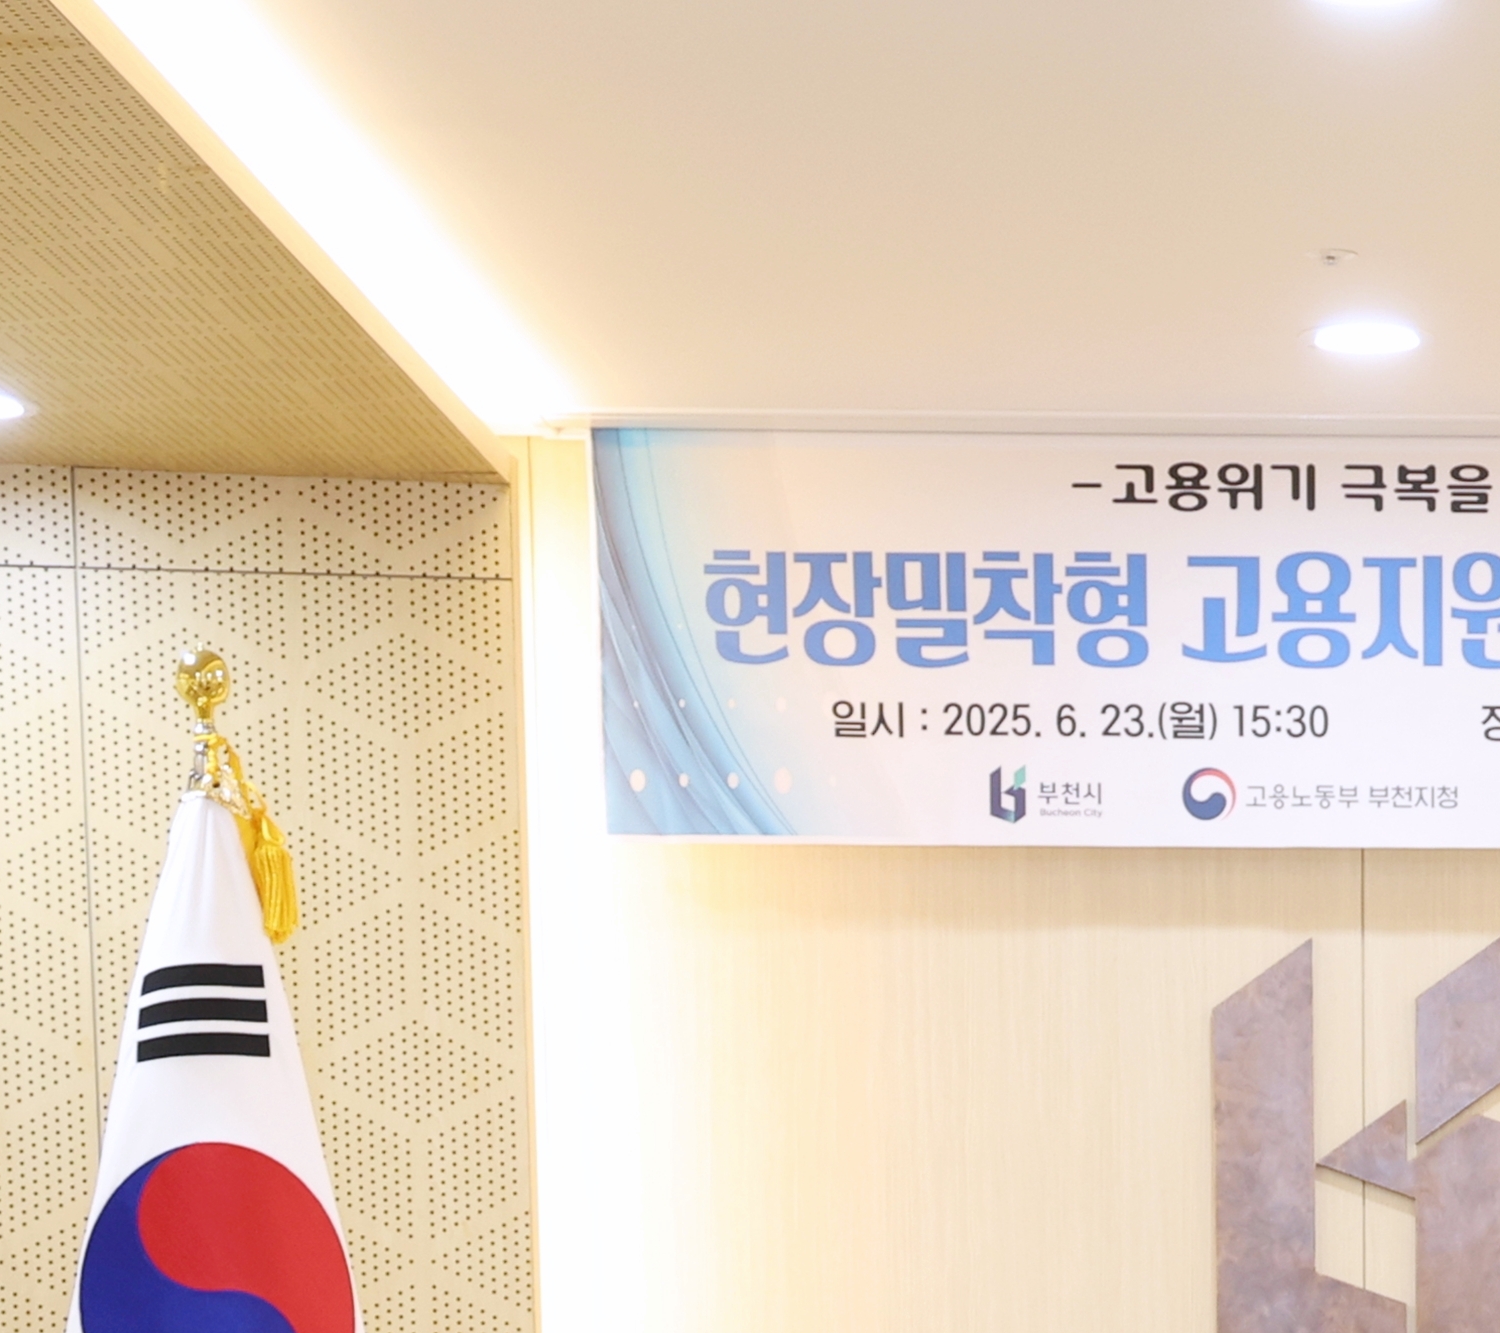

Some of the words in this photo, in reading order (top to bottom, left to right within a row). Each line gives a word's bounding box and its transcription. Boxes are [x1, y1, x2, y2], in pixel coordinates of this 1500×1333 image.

[1341, 464, 1492, 513] 극복을
[704, 550, 1148, 668] 현장밀착형
[832, 701, 904, 738] 일시
[943, 703, 1041, 737] 2025.
[1057, 704, 1085, 737] 6.
[1101, 702, 1217, 740] 23.(월)
[1234, 705, 1328, 738] 15:30
[1038, 783, 1101, 805] 부천시
[1246, 784, 1358, 810] 고용노동부
[1369, 786, 1458, 809] 부천지청
[1040, 808, 1081, 816] Bucheon
[1084, 808, 1102, 818] City
